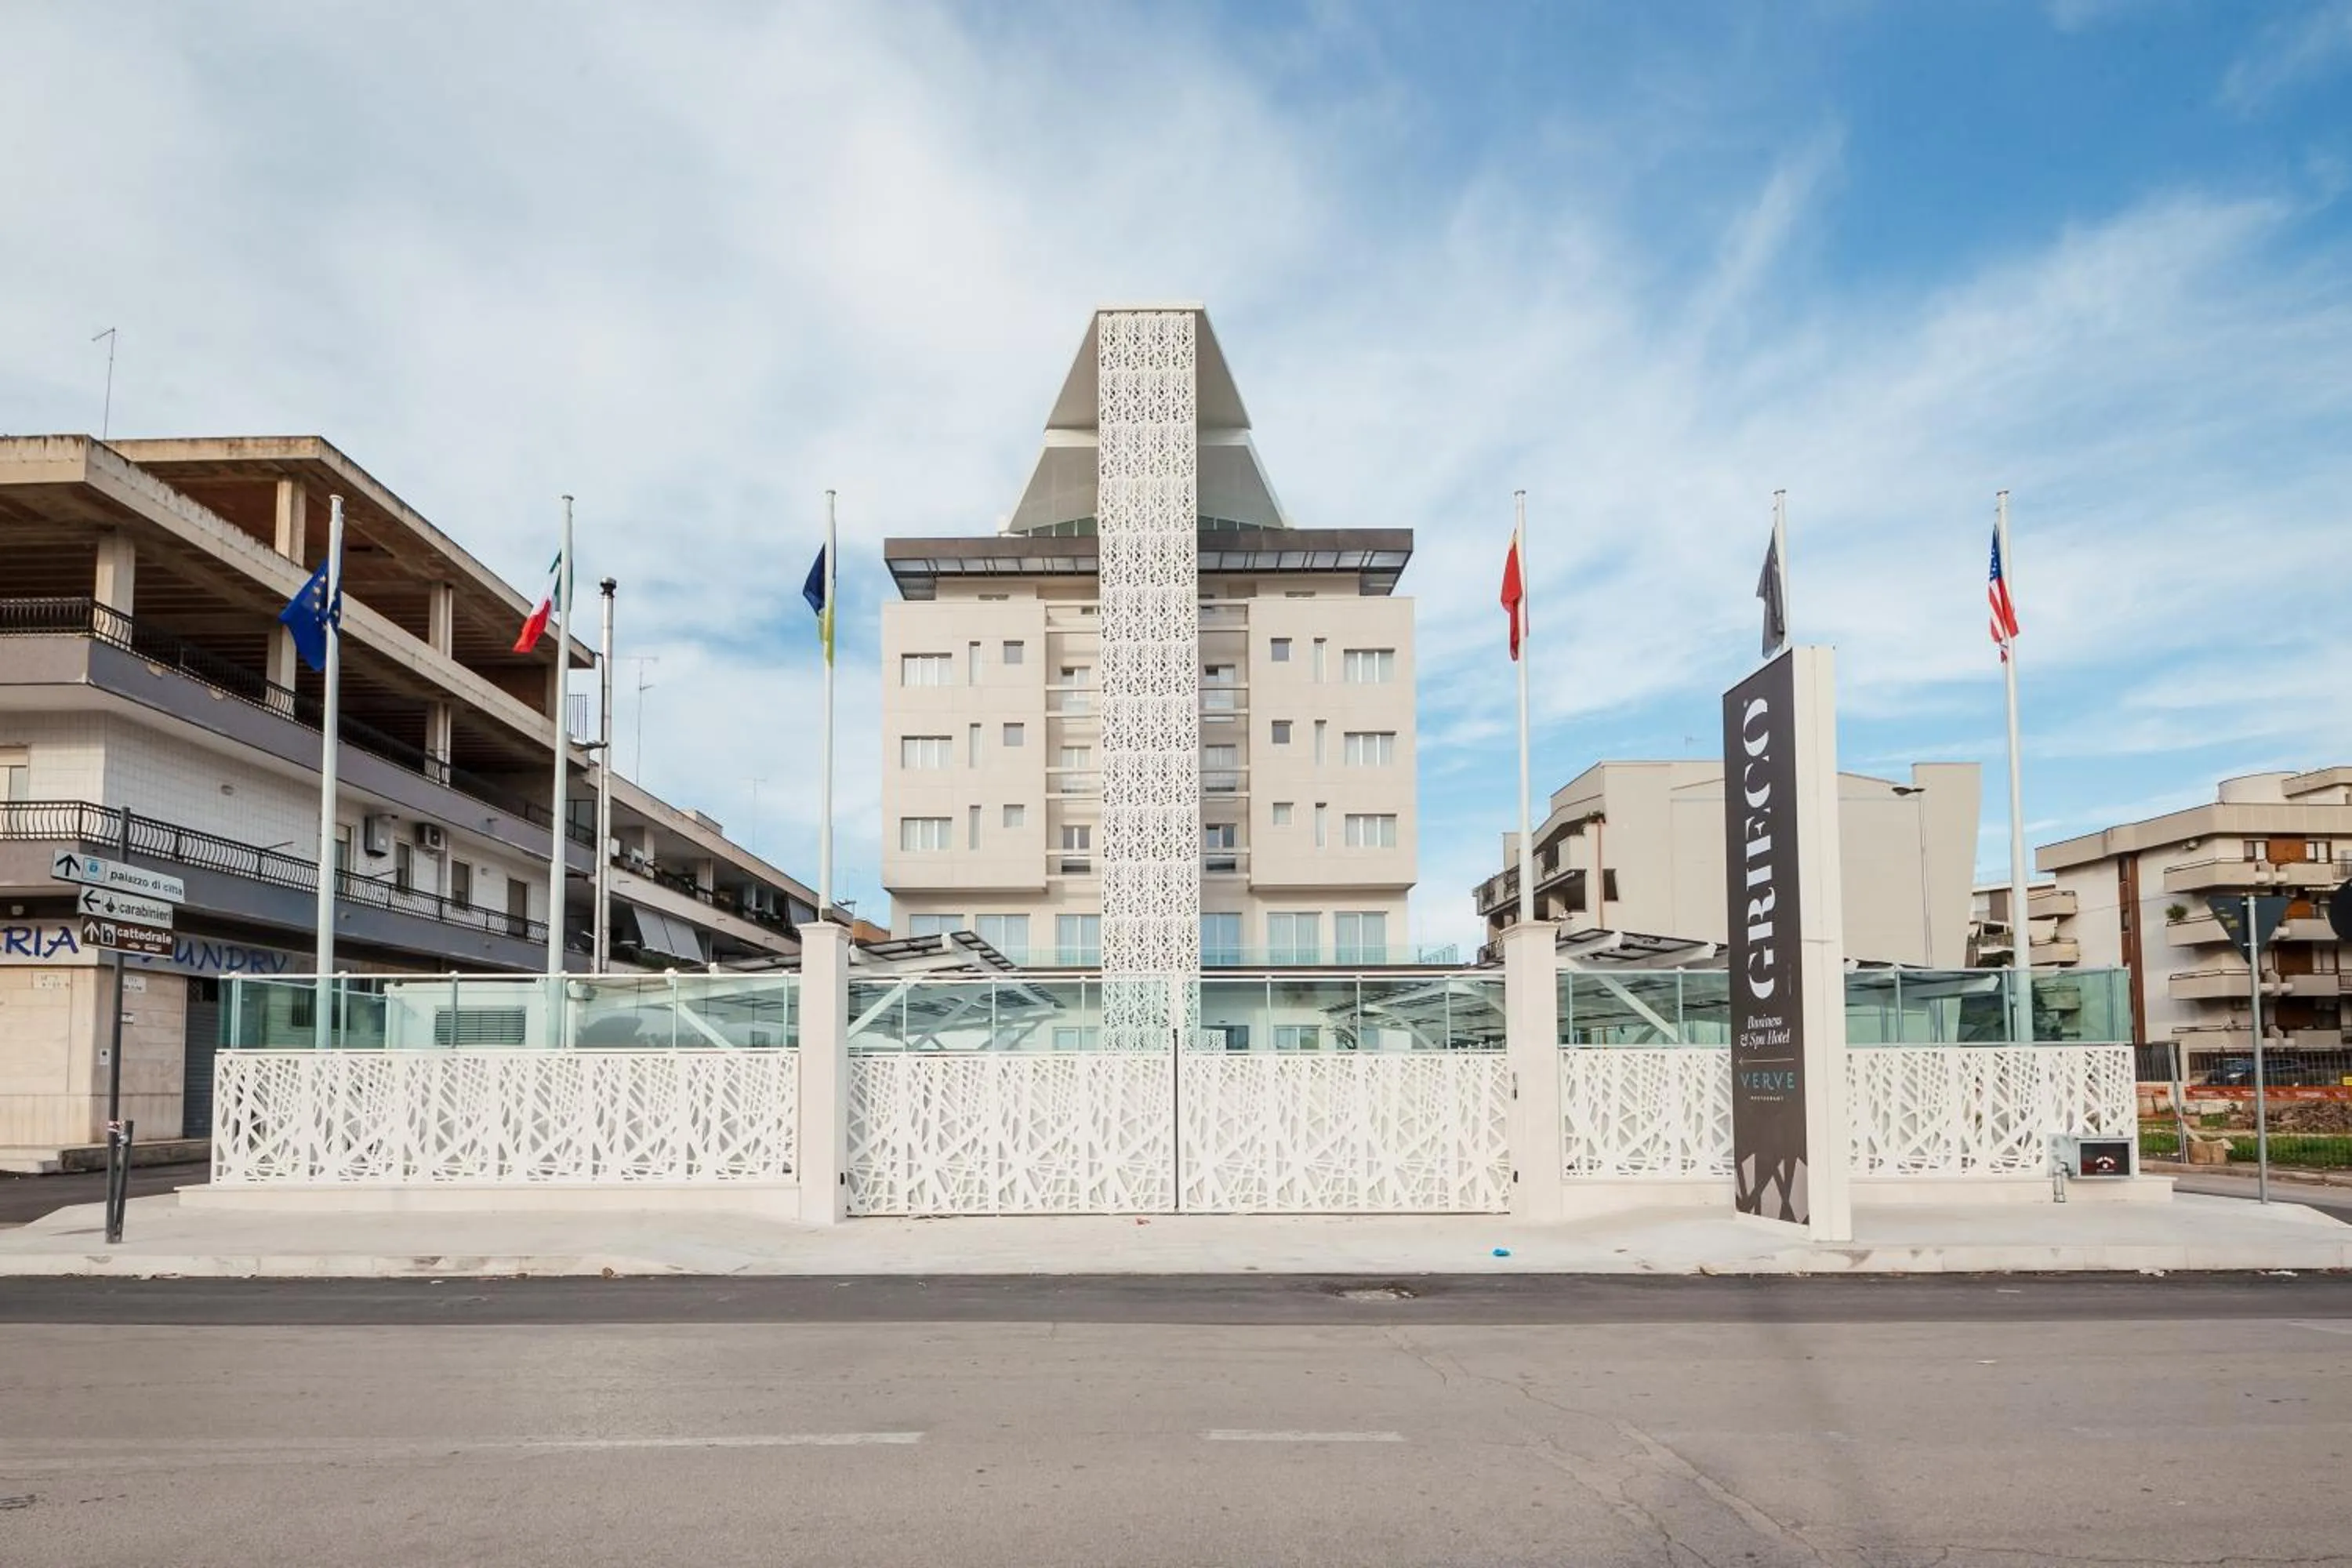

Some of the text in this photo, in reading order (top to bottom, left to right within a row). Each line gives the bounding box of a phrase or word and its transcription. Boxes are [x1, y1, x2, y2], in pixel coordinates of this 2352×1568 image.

[1744, 698, 1776, 1000] GRIECO
[110, 870, 150, 887] palazzo
[151, 880, 161, 890] di
[118, 903, 172, 923] carabinieri
[0, 926, 79, 959] RIA
[118, 927, 172, 945] cattedrale
[1767, 1028, 1791, 1045] Hotel
[1740, 1071, 1795, 1090] VERVE
